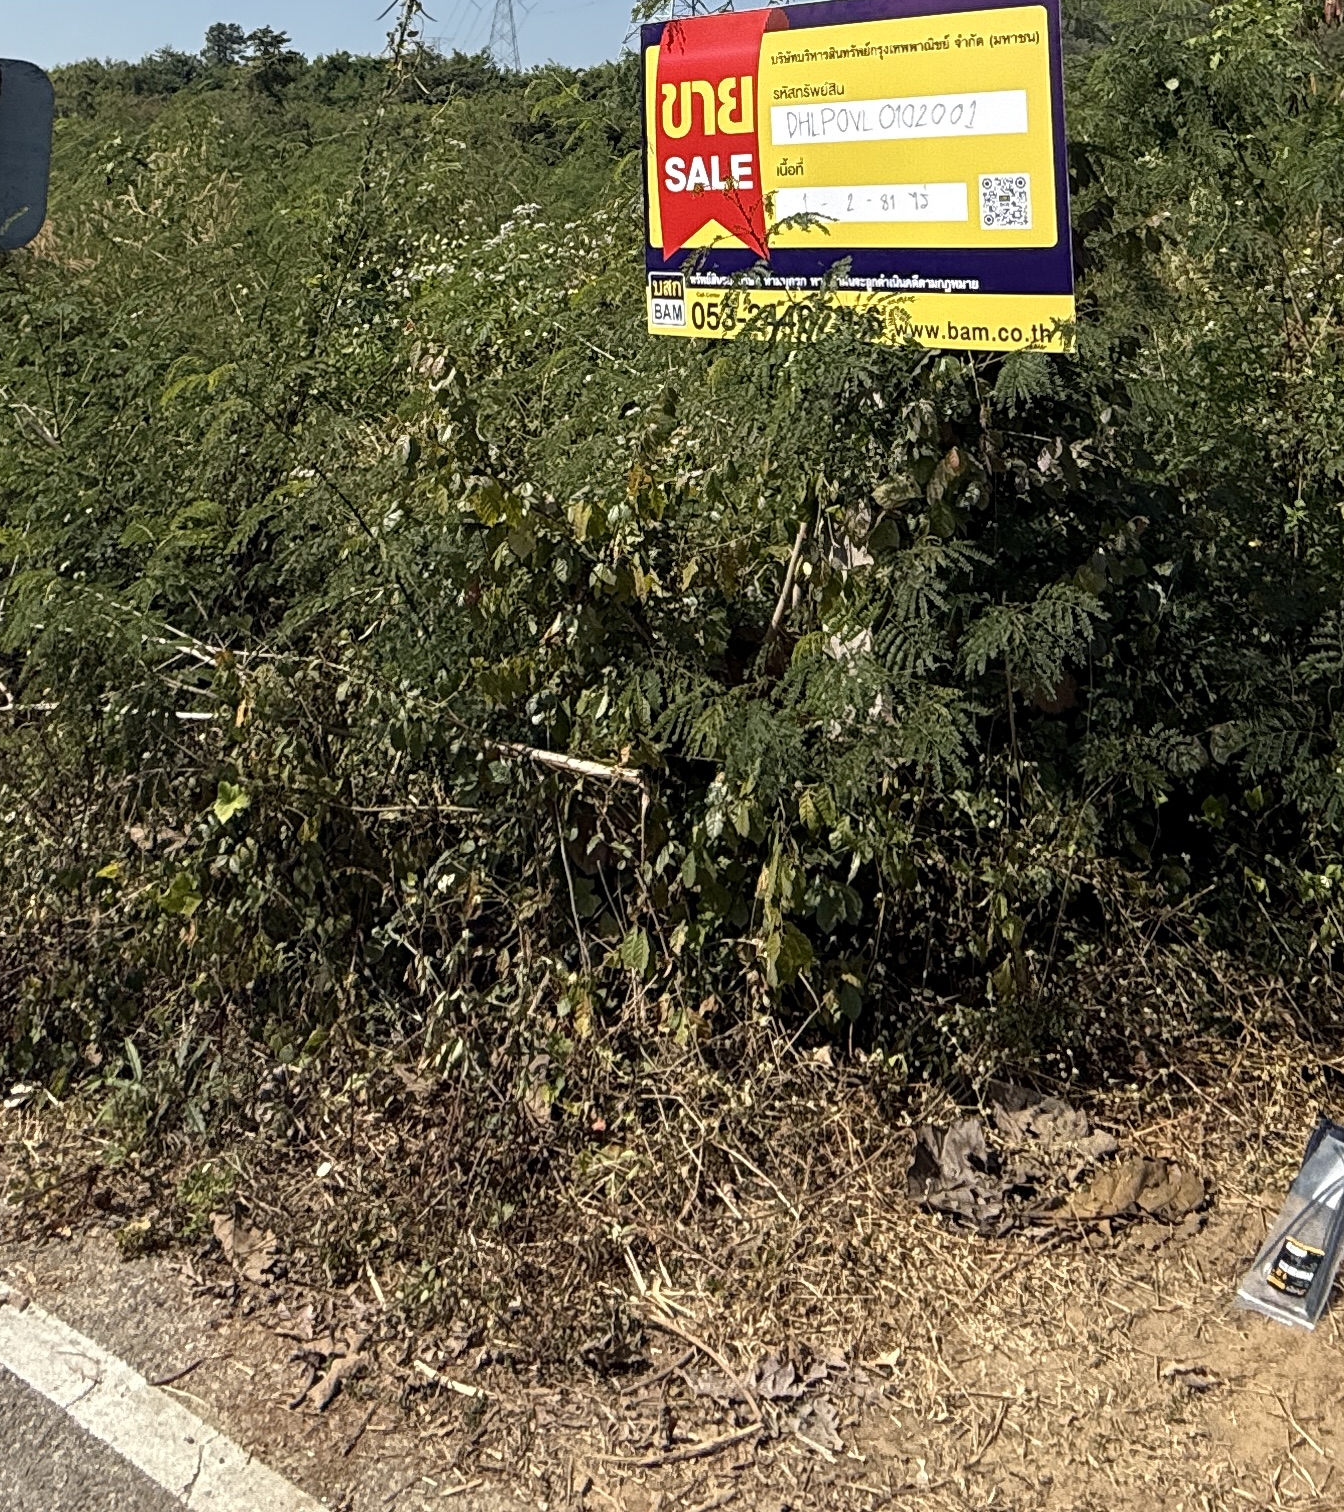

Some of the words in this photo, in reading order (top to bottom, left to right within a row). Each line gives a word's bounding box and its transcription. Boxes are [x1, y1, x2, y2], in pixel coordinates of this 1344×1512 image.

[955, 33, 984, 49] จำกัด
[989, 31, 1041, 49] (มหาชน)
[772, 82, 845, 101] รหัสทรัพย์สิน
[661, 75, 755, 139] ขาย
[664, 153, 754, 193] SALE
[776, 157, 804, 177] เนื้อที่
[652, 278, 682, 298] บสก
[654, 303, 683, 322] BAM
[895, 320, 1052, 343] www.bam.co.th
